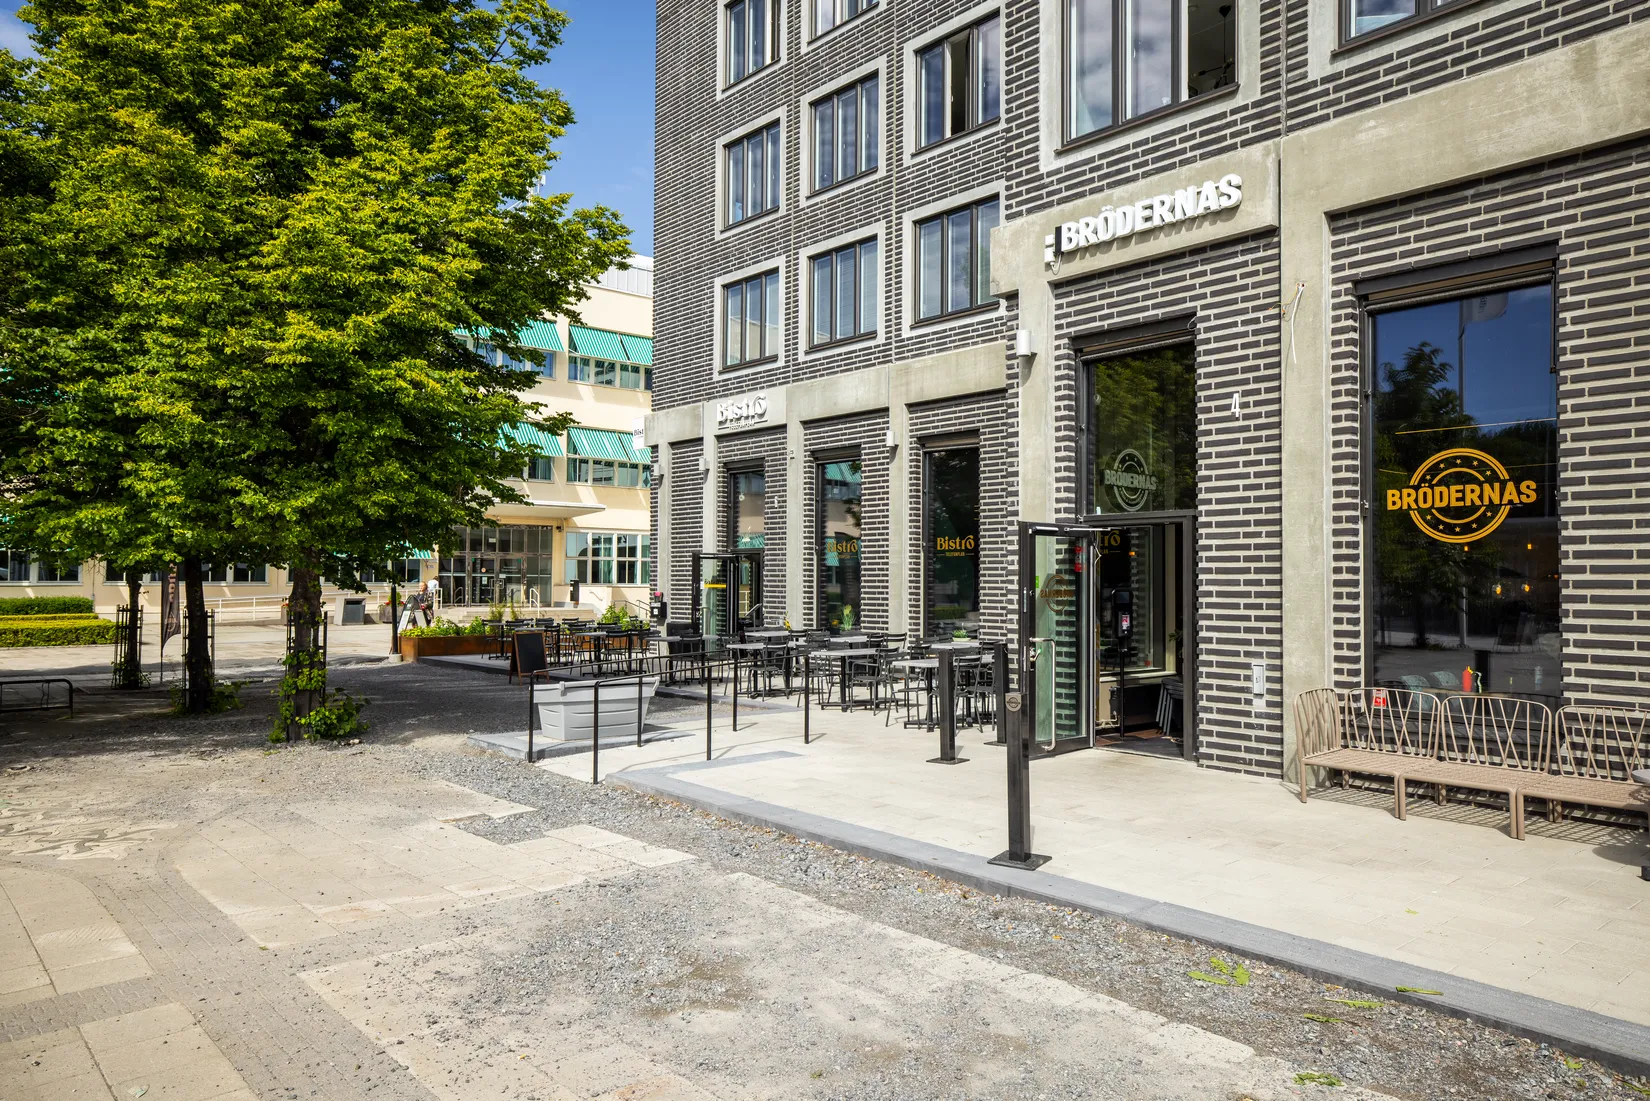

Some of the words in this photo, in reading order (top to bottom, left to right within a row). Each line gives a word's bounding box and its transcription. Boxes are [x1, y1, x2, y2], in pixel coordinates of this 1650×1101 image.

[1061, 173, 1242, 252] BRÖDERNAS
[1230, 393, 1241, 418] 4
[1386, 480, 1537, 511] BRÖDERNAS
